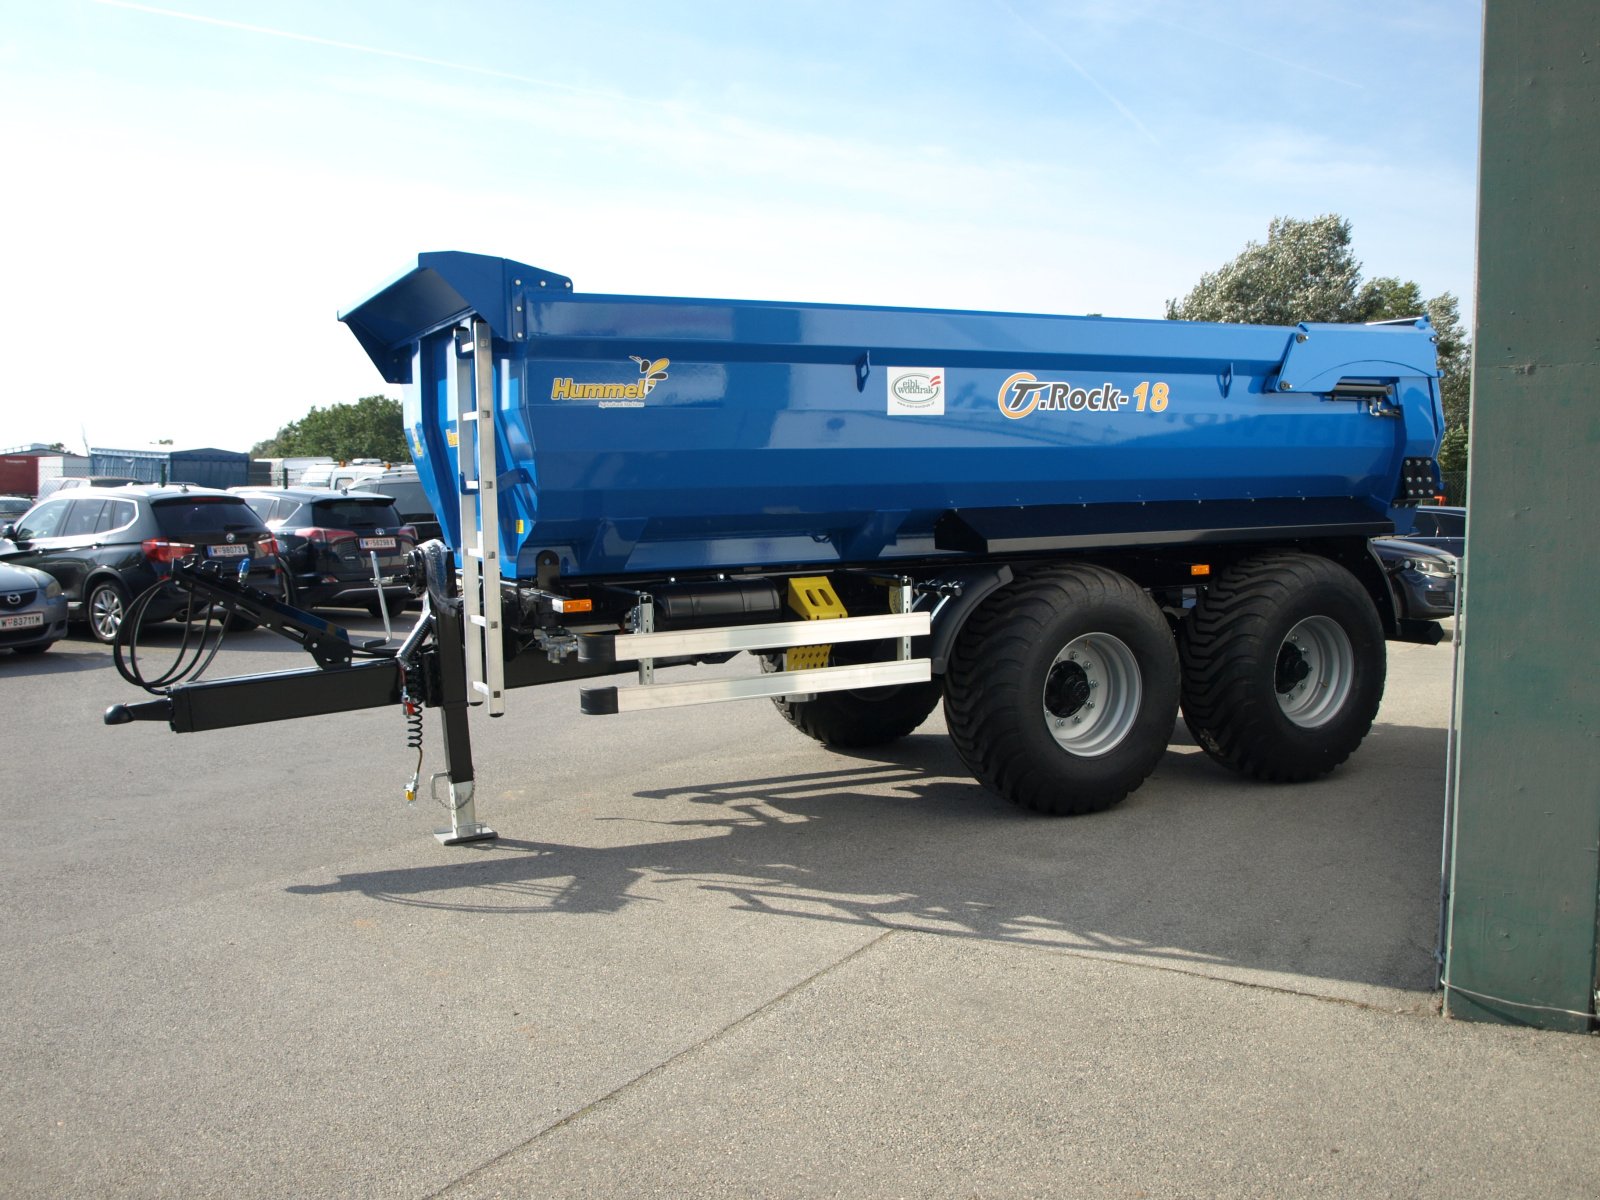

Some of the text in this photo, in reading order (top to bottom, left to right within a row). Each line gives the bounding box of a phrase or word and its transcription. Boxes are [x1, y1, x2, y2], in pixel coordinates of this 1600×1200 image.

[551, 378, 647, 400] Hummel
[898, 385, 933, 394] wondrak
[1132, 381, 1170, 413] 18
